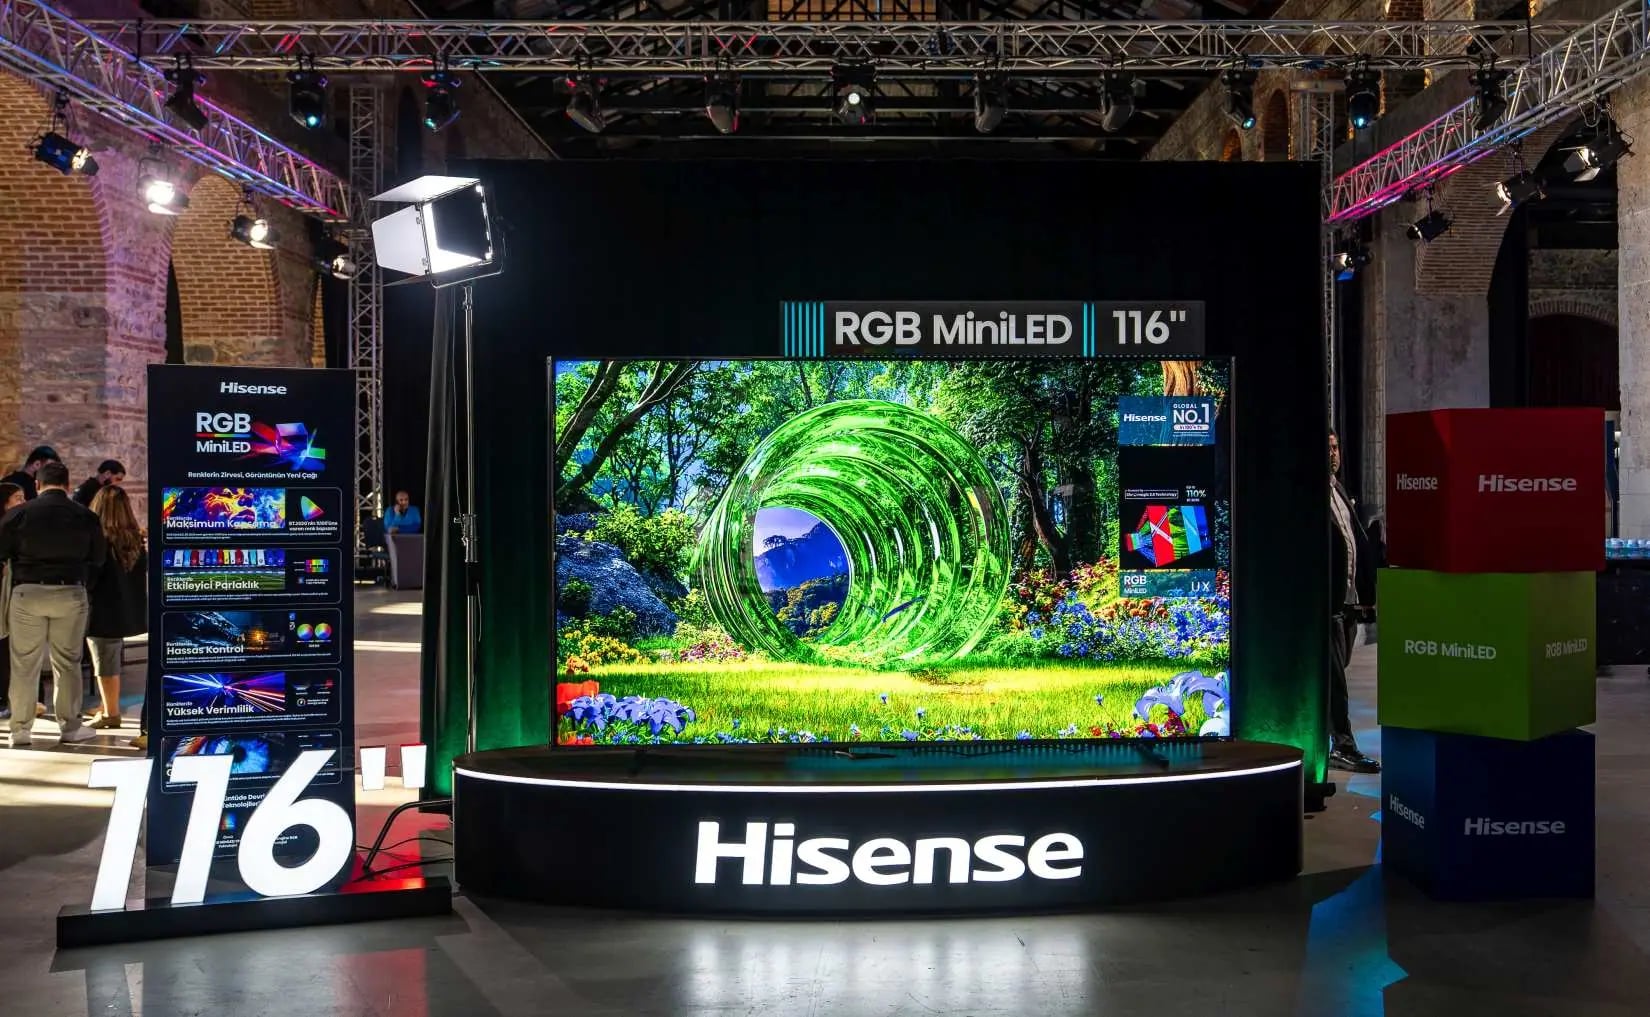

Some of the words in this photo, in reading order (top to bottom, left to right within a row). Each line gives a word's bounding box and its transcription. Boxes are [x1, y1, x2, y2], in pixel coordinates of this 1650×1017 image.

[835, 311, 921, 345] RGB
[934, 311, 1073, 345] MiniLED
[1112, 310, 1187, 344] 116"
[220, 381, 288, 395] Hisense
[1123, 413, 1167, 422] Hisense
[1173, 403, 1210, 424] NO.1
[196, 412, 251, 433] RGB
[196, 440, 251, 454] MiniLED
[220, 471, 244, 479] Zirvesi,
[245, 471, 286, 479] Görüntünün
[301, 472, 318, 480] Çağı
[1396, 473, 1438, 491] Hisense
[1478, 474, 1577, 492] Hisense
[1186, 489, 1206, 498] 110%
[166, 519, 225, 529] Maksimum
[166, 580, 213, 592] Etkileyici
[215, 580, 260, 590] Parlaklık
[1123, 575, 1147, 585] RGB
[1191, 581, 1210, 592] UX
[166, 646, 204, 655] Hassas
[206, 644, 244, 654] Kontrol
[1405, 639, 1437, 656] RGB
[1441, 642, 1497, 660] MiniLED
[1545, 642, 1562, 658] RGB
[1562, 638, 1588, 655] MiniLED
[166, 706, 204, 716] Yüksek
[206, 704, 255, 714] Verimlilik
[1389, 793, 1425, 829] Hisense
[87, 743, 427, 912] 116"
[1463, 817, 1566, 836] Hisense
[694, 820, 1084, 886] Hisense
